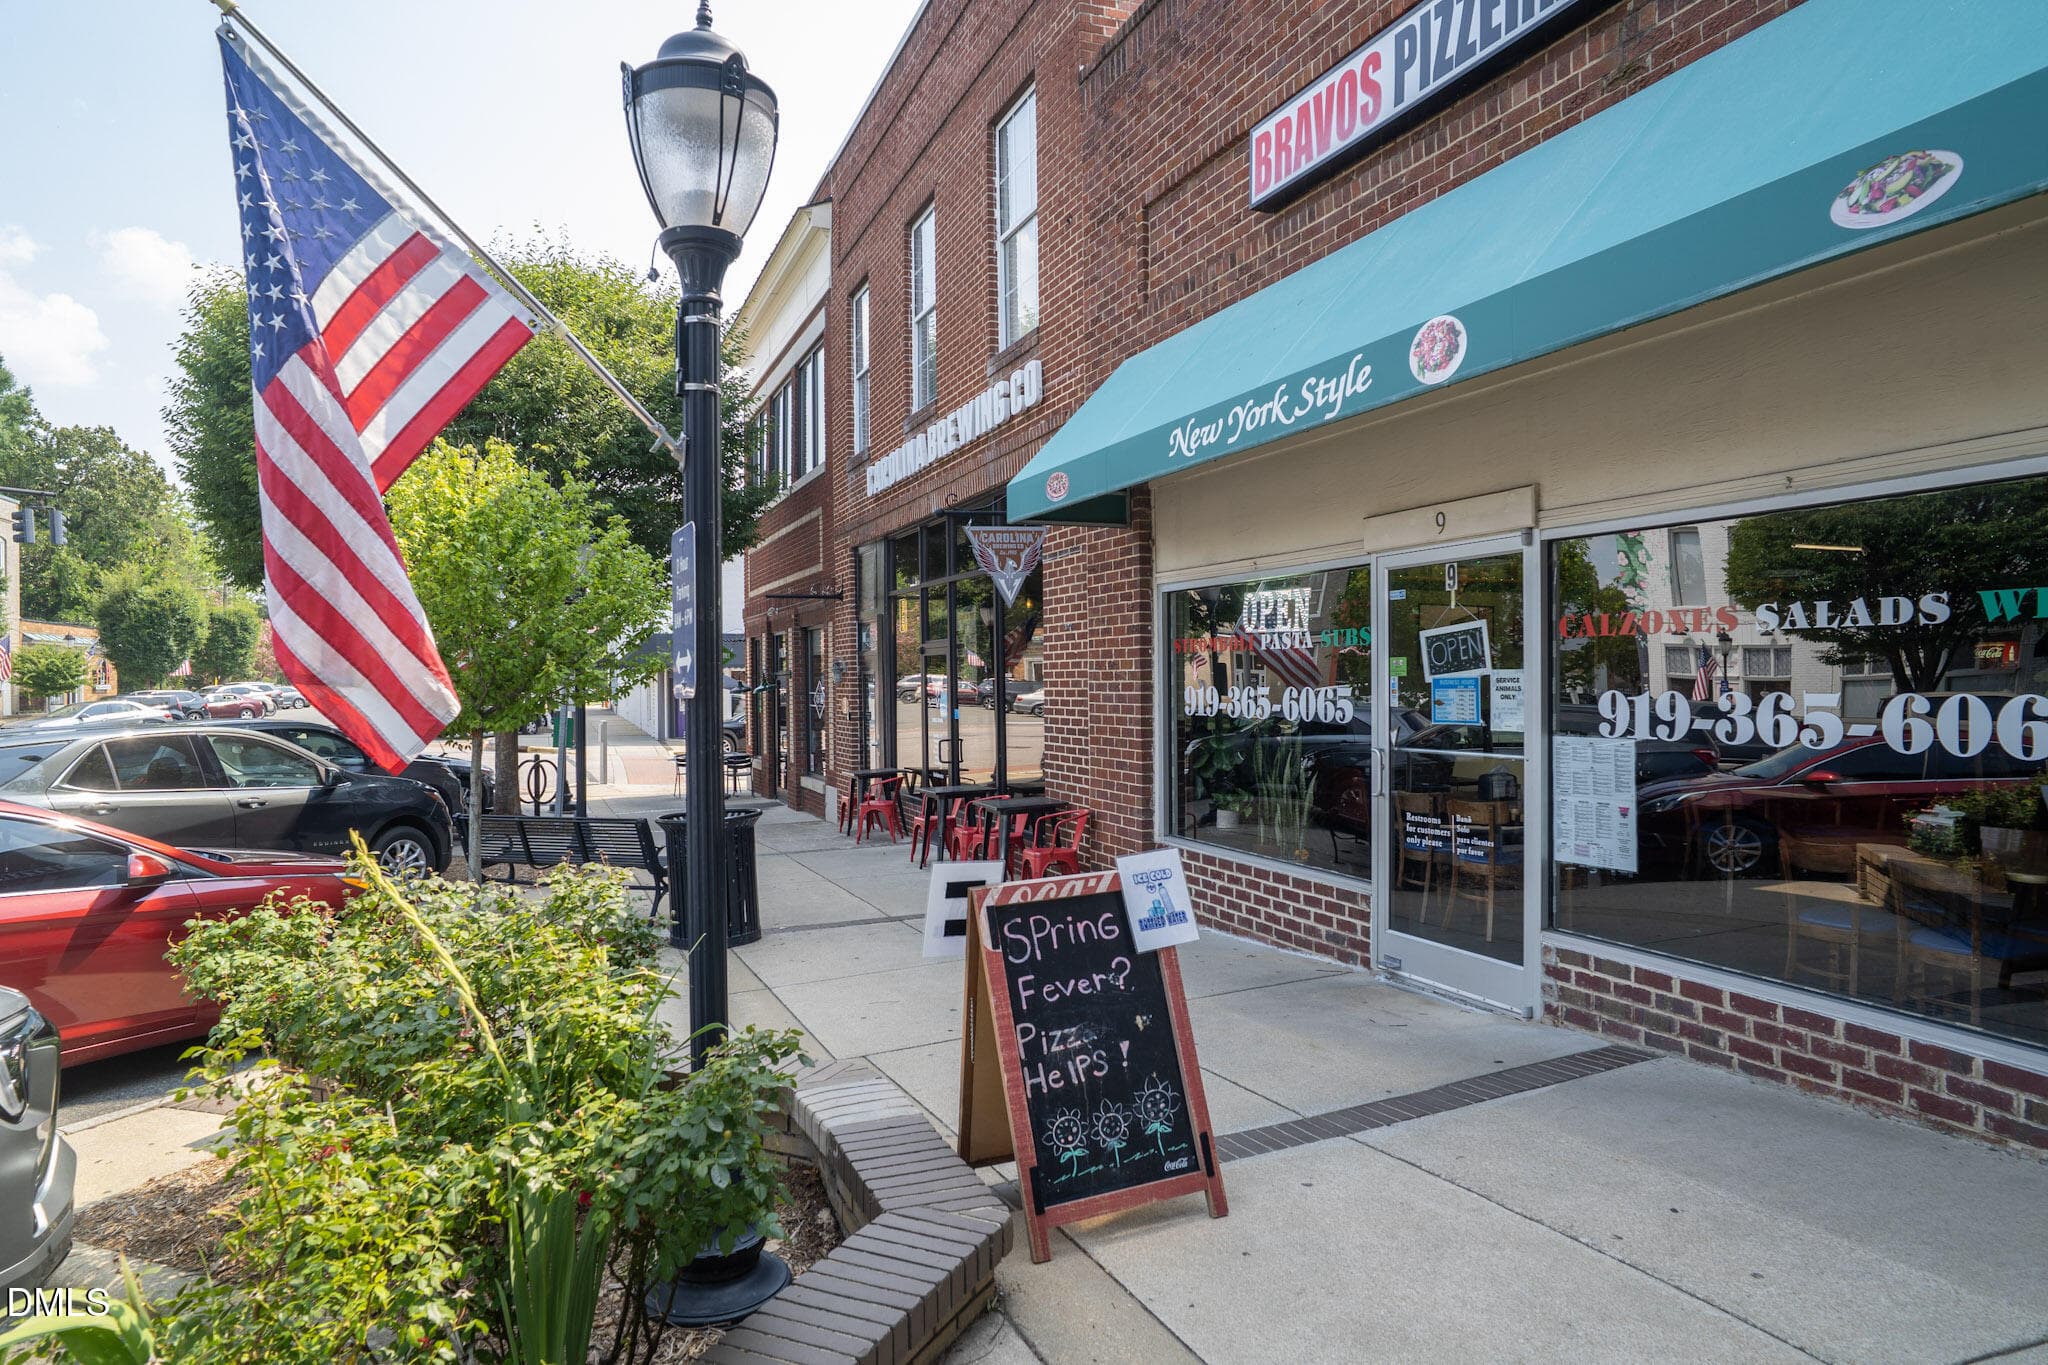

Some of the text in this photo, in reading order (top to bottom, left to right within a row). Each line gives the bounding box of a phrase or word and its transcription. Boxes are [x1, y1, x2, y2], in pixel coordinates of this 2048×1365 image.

[1254, 0, 1555, 197] BRAVOS PIZZE
[927, 380, 1010, 466] BREWING
[1010, 359, 1043, 416] CO
[1169, 353, 1372, 457] New York Style
[1436, 511, 1446, 535] 9
[981, 532, 1034, 544] CAROLINA
[1448, 564, 1456, 589] 9
[1242, 588, 1312, 633] OPEN
[1559, 605, 1739, 639] CALZONES
[1755, 591, 1950, 631] SALADS
[1261, 631, 1313, 650] PASTA
[1320, 626, 1371, 648] SUBS
[1431, 633, 1482, 666] OPEN
[1184, 686, 1354, 724] 919-365-6065
[1598, 689, 2048, 761] 919-365-606
[1406, 812, 1441, 825] Restrooms
[1406, 823, 1451, 837] for customers
[1406, 835, 1443, 848] only please
[1456, 837, 1494, 847] para clientes
[1468, 847, 1484, 857] favor
[1133, 868, 1173, 885] ICE COLD
[1167, 910, 1188, 926] WATER
[1017, 956, 1131, 1010] Fever?
